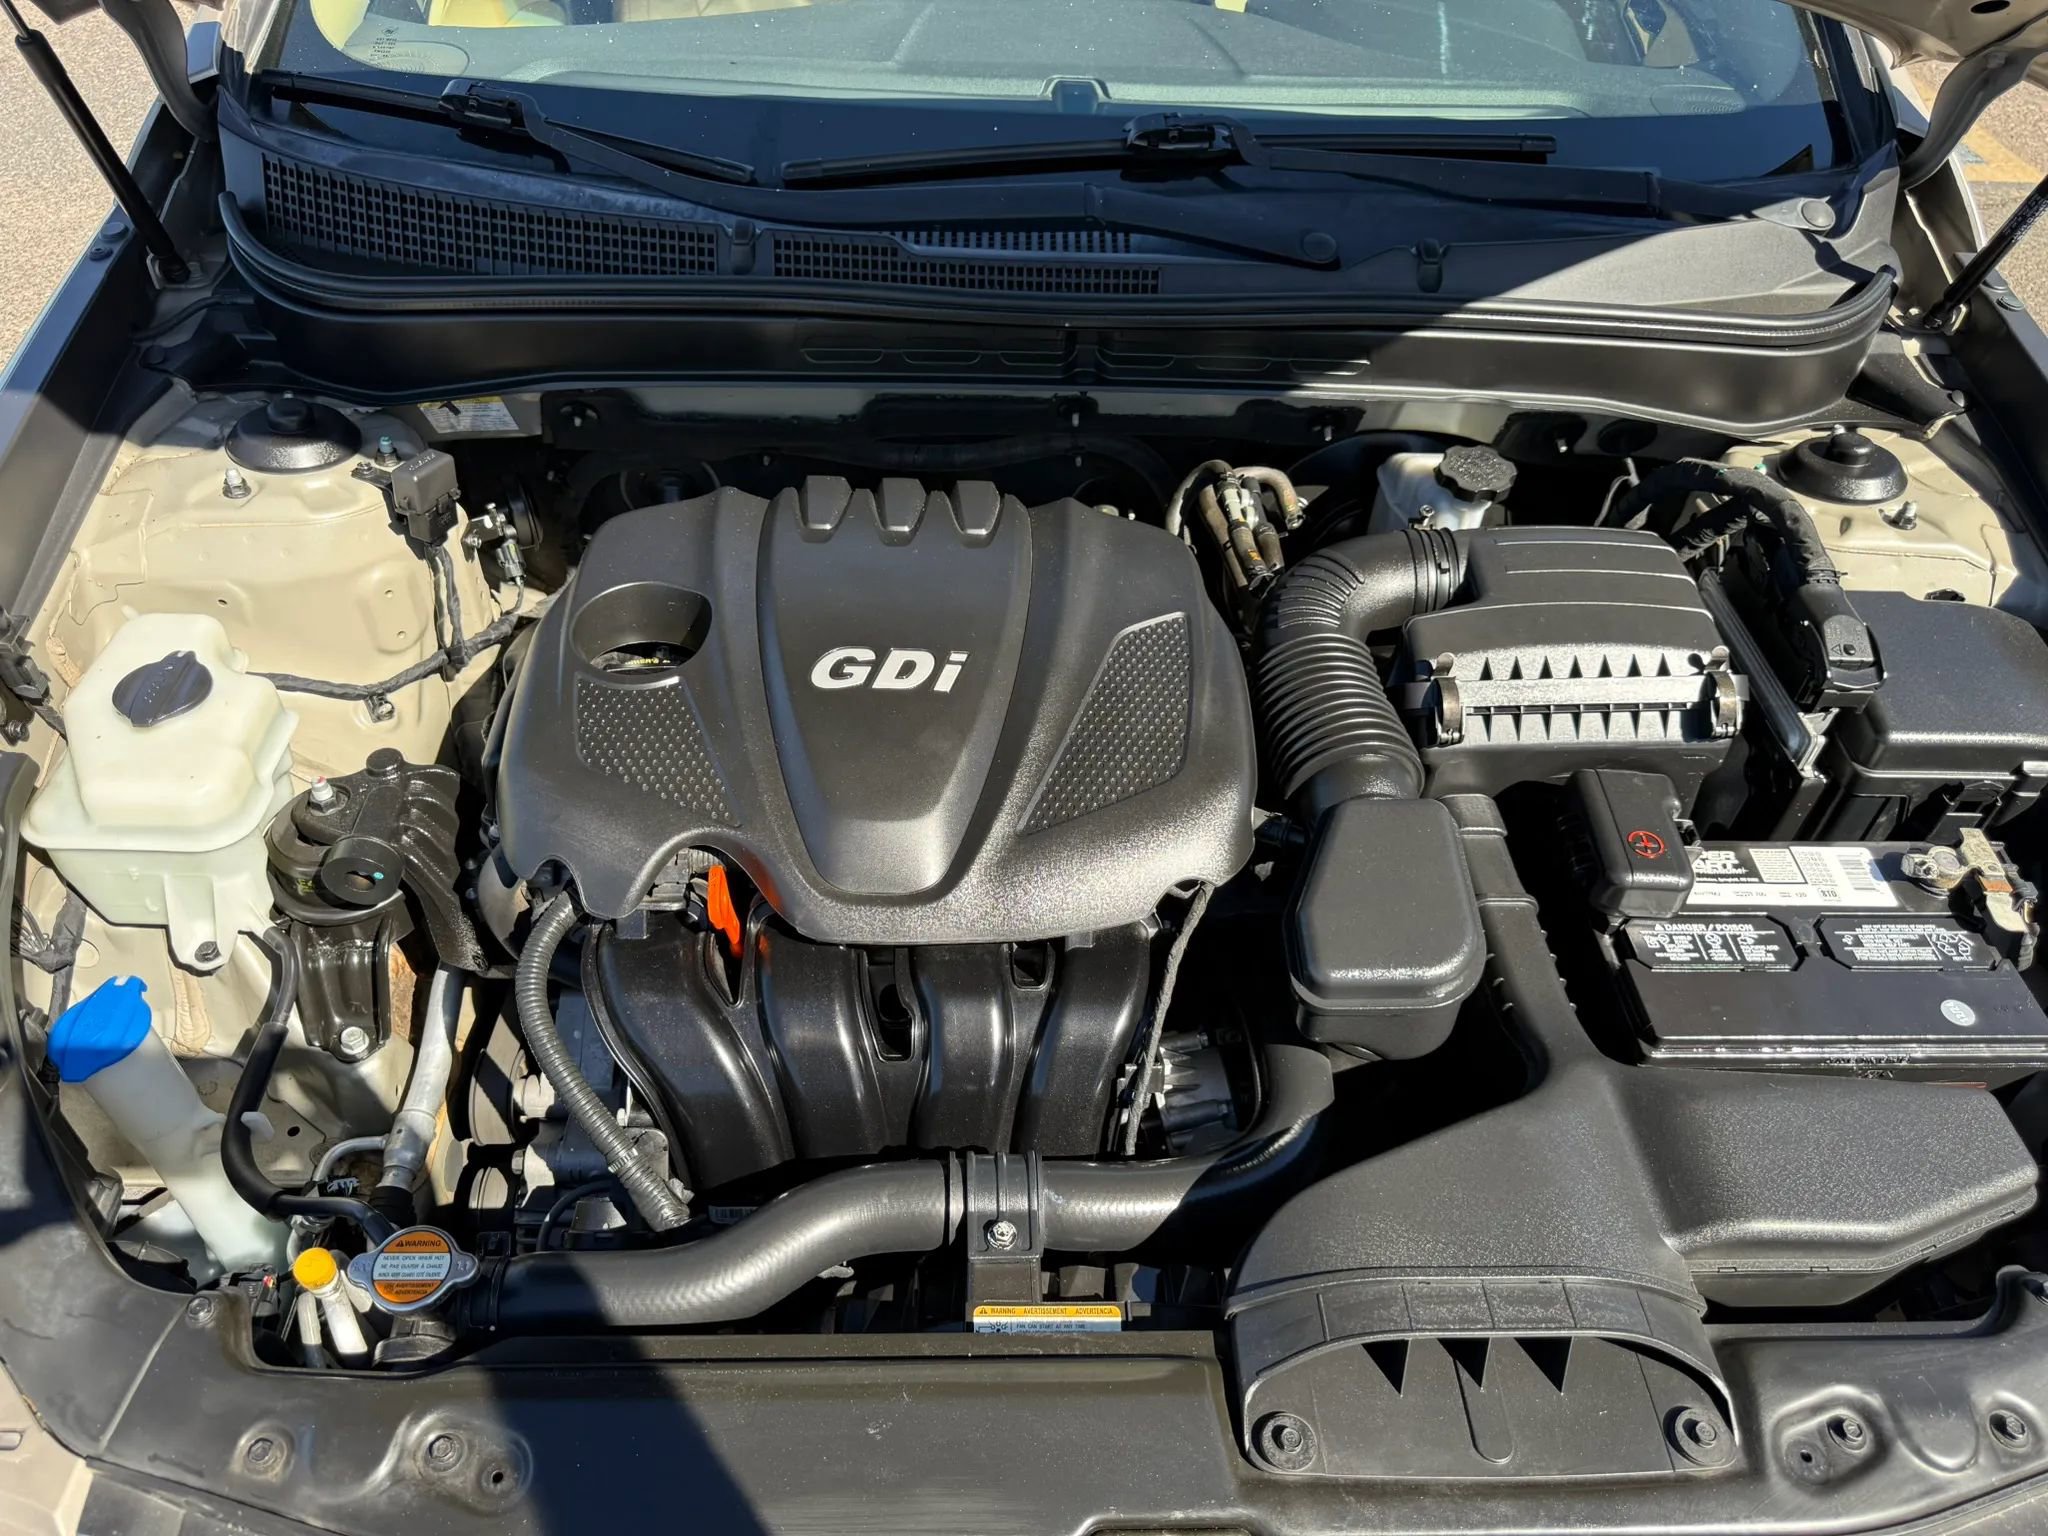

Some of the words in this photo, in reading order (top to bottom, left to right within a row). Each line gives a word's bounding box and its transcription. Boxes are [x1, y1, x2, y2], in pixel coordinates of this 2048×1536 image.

[810, 645, 970, 694] GDi
[1663, 923, 1707, 931] DANGER
[1715, 923, 1754, 931] POISON
[404, 1239, 441, 1248] WARNING
[991, 1307, 1016, 1315] WARNING
[1023, 1307, 1067, 1315] AVERTISSEMENT
[1075, 1307, 1113, 1315] ADVERTENCIA
